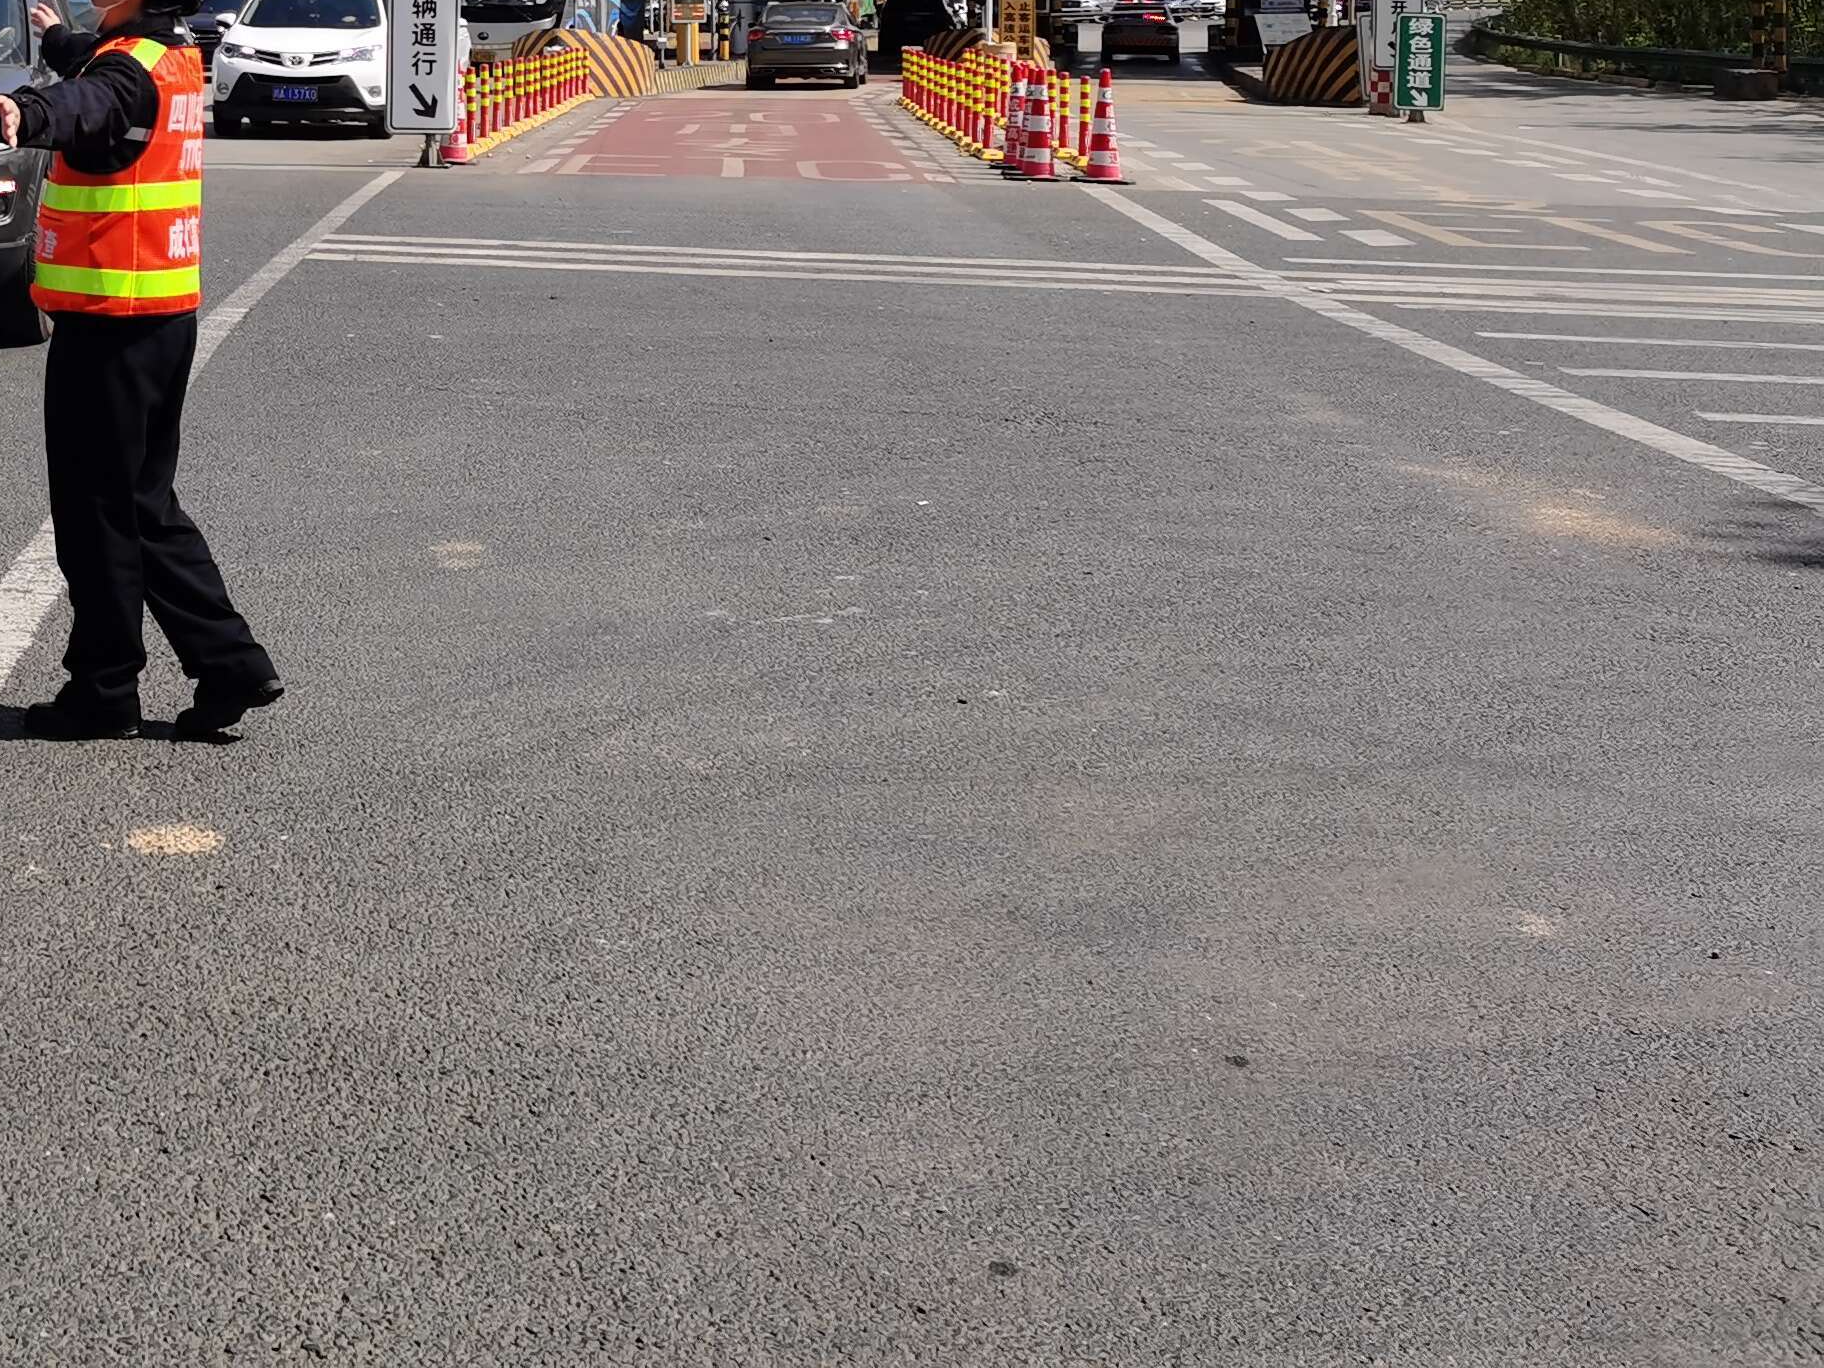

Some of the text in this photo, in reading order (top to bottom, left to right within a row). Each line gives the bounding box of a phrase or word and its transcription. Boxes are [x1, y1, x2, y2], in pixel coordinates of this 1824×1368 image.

[1407, 18, 1434, 88] 绿色通道
[556, 154, 913, 182] ETC
